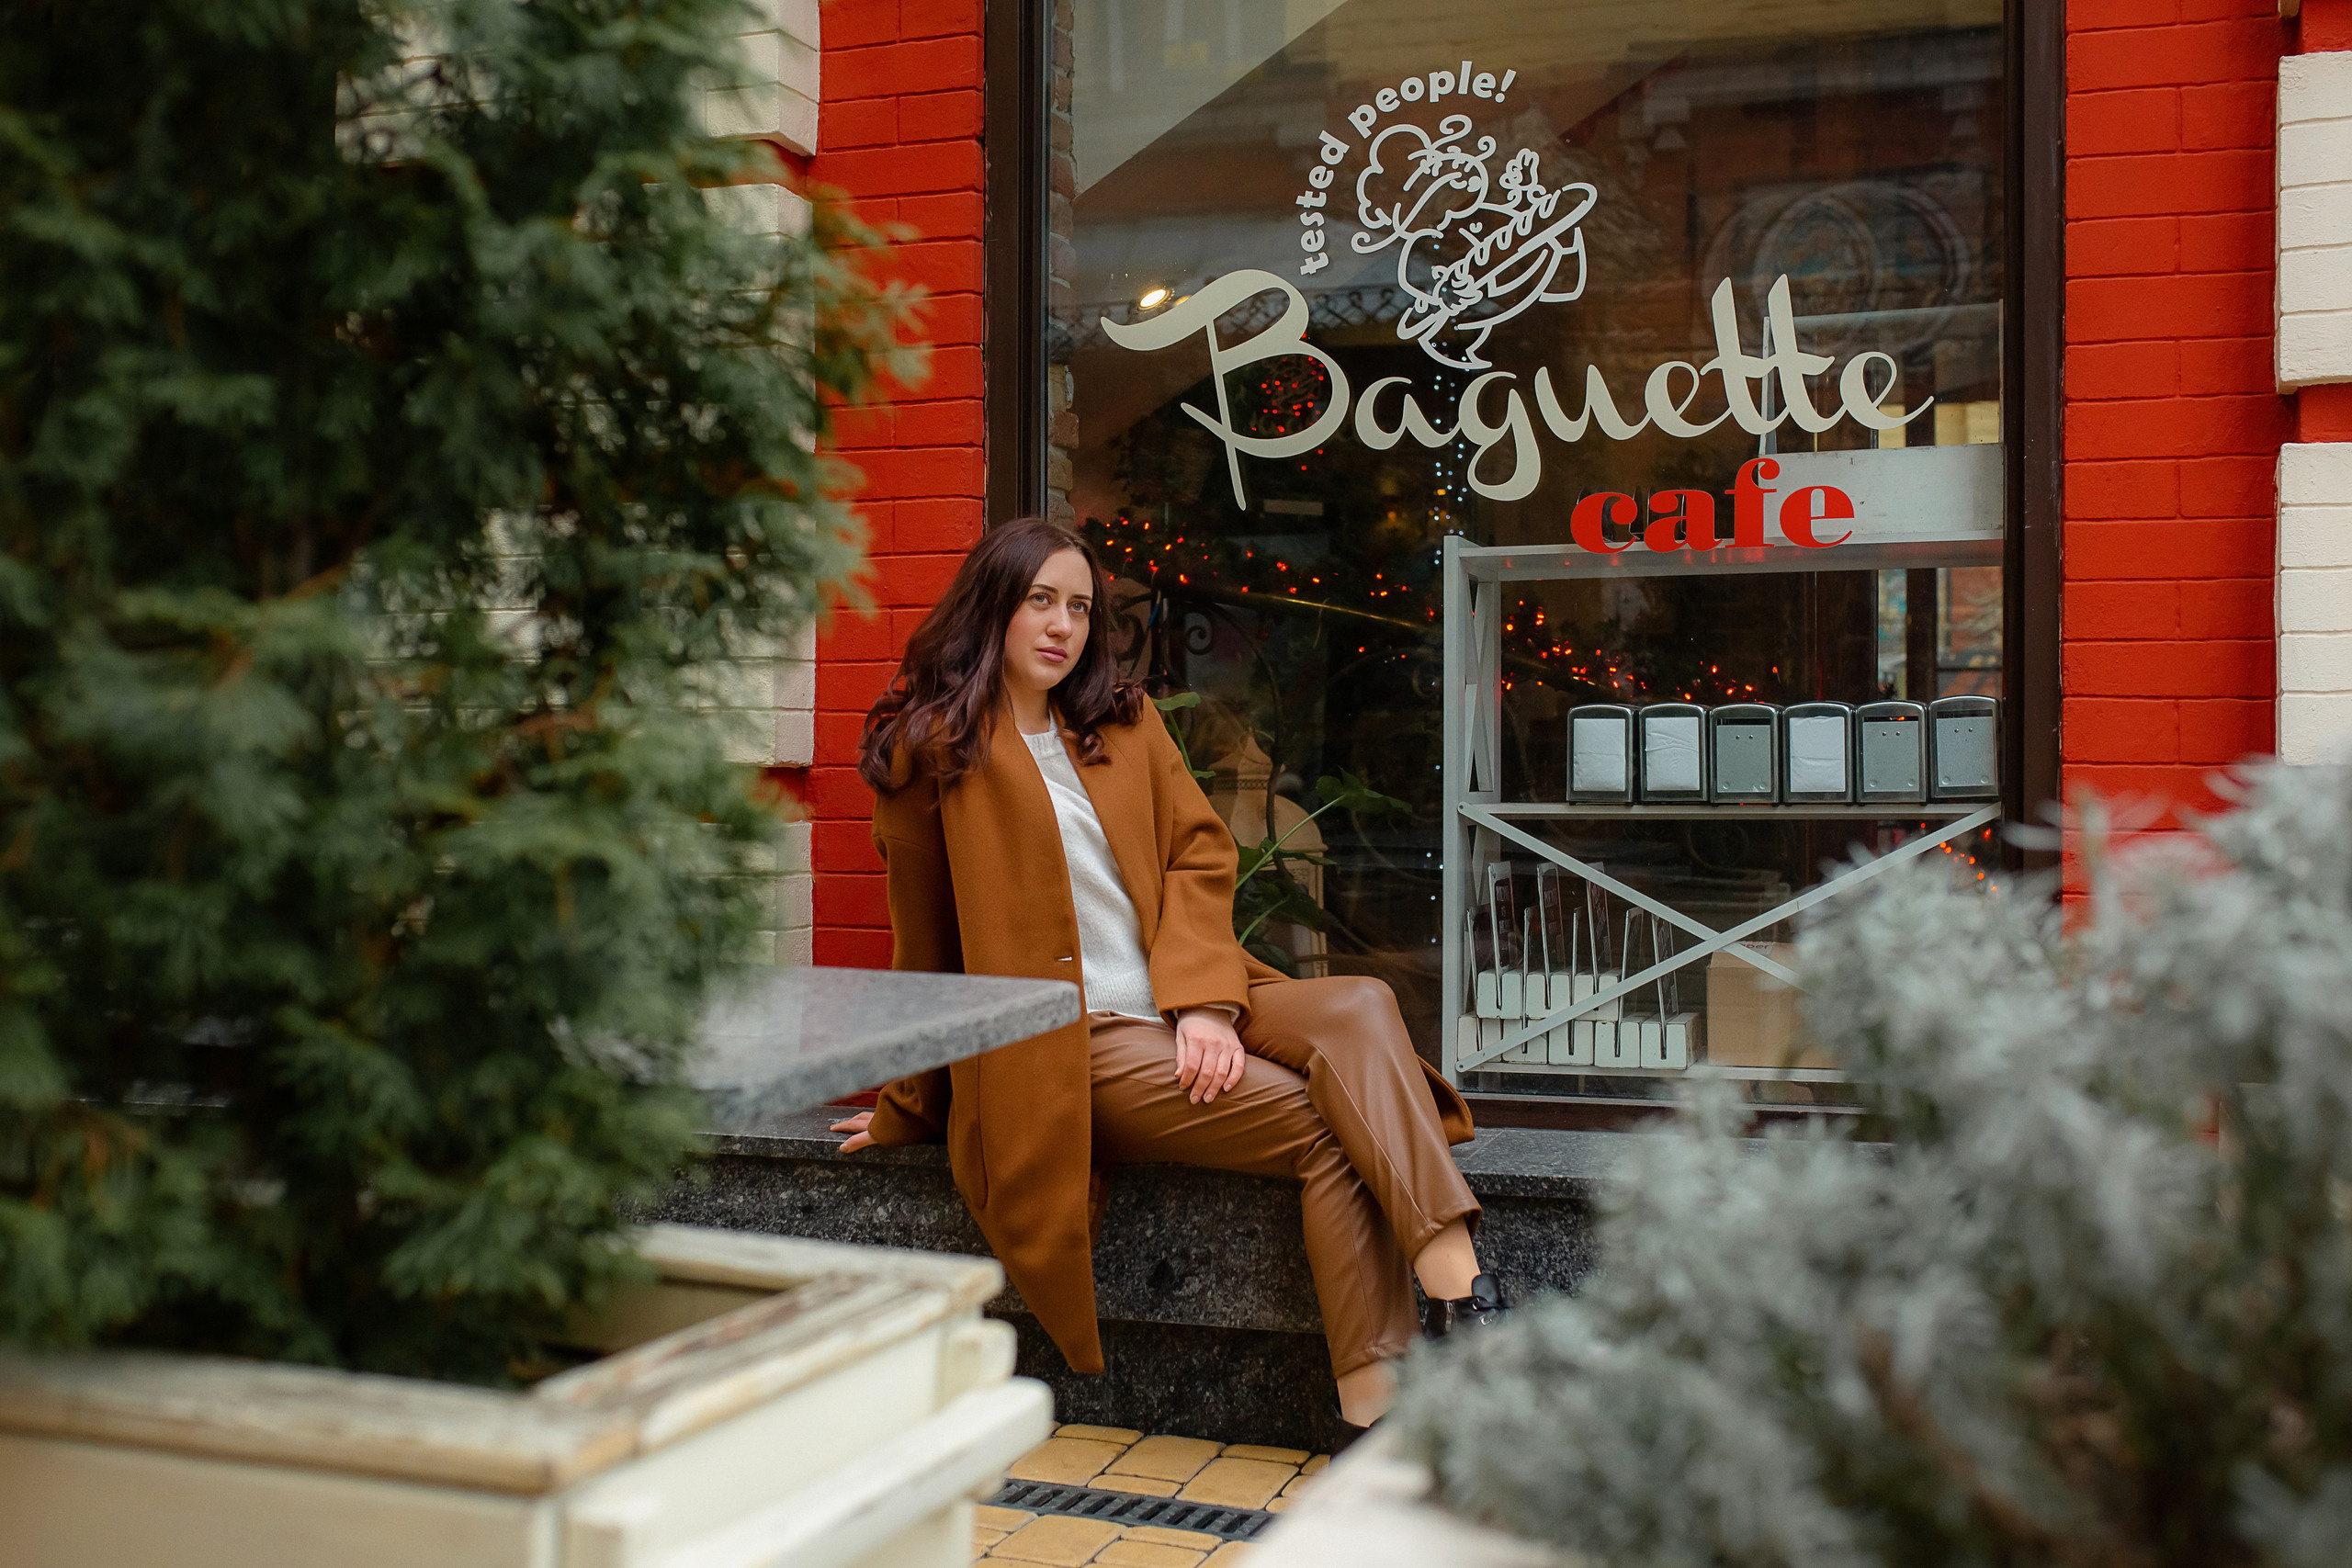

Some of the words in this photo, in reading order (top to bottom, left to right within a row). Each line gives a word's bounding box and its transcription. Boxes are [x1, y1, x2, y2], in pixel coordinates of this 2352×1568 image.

[1295, 130, 1351, 276] tested
[1347, 60, 1517, 139] people!
[1101, 268, 1935, 512] Baguette
[1570, 457, 1855, 555] cafe
